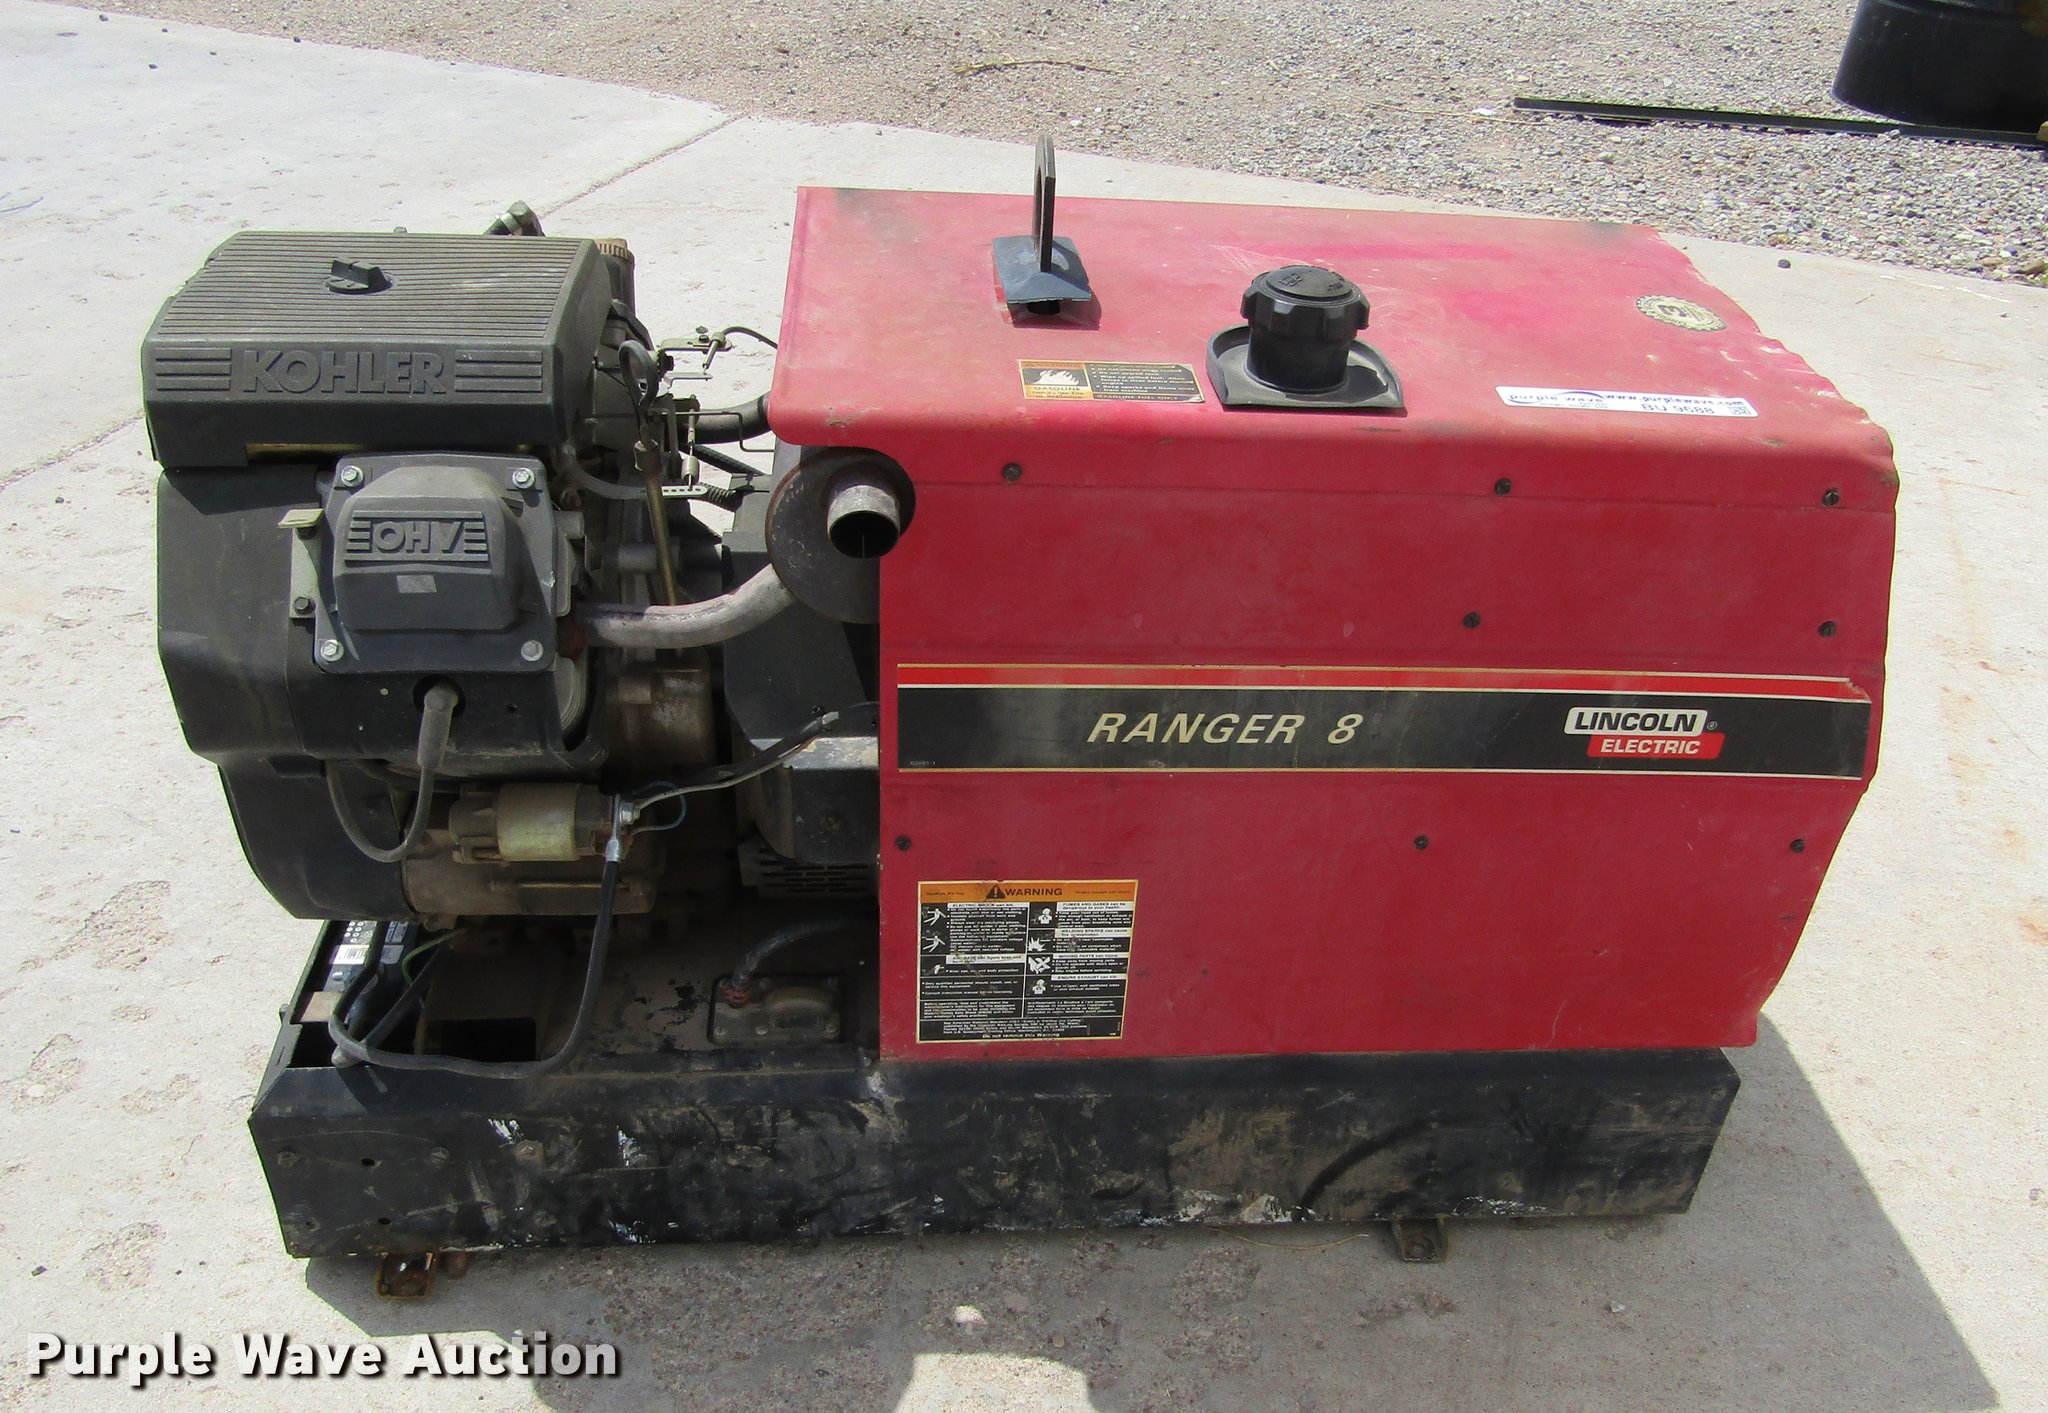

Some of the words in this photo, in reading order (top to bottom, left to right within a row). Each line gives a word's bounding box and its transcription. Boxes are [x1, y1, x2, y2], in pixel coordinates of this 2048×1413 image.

[243, 350, 446, 394] KOHLER
[372, 520, 461, 553] OHV
[1085, 713, 1305, 744] RANGER
[1327, 713, 1364, 744] 8
[1574, 711, 1697, 732] LINCOLN
[1600, 738, 1700, 755] ELECTRIC
[1005, 888, 1063, 897] WARNING
